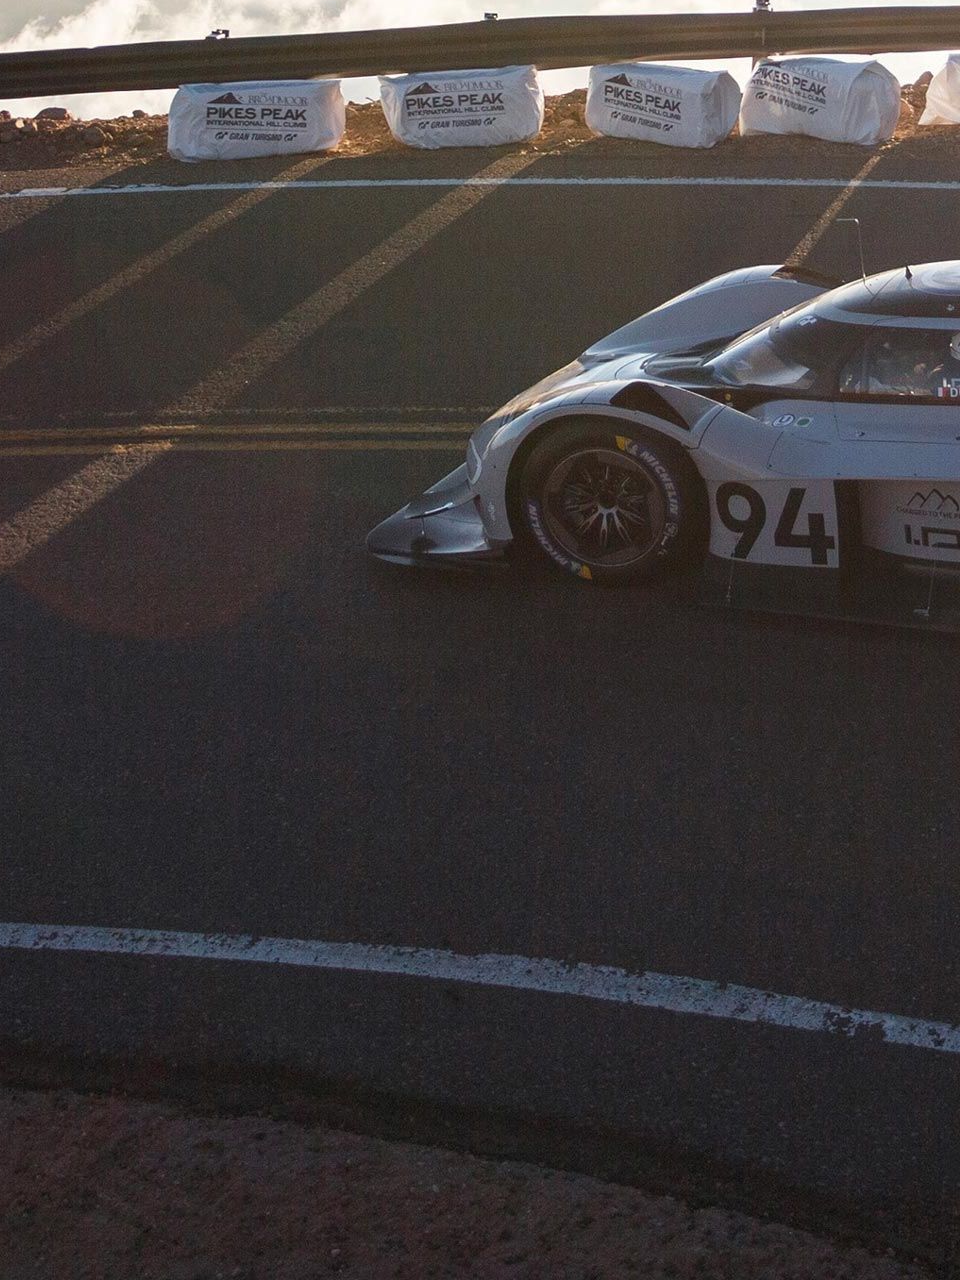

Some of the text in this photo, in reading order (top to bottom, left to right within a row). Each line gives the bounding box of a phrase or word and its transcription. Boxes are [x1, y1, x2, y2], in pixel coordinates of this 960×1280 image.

[753, 66, 790, 85] PIKES
[792, 76, 827, 97] PEAK
[405, 92, 504, 110] PIKES PEAK
[604, 84, 682, 113] PIKES PEAK
[604, 97, 681, 120] INTERNATIONAL HILL CLIMB
[206, 107, 306, 121] PIKES PEAK
[407, 109, 463, 117] INTERNATIONAL
[430, 119, 482, 129] GRAN TURISMO
[229, 132, 282, 141] GRAN TURISMO
[641, 450, 679, 516] MICHELIN
[527, 503, 569, 566] MICHELIN
[715, 481, 835, 565] 94
